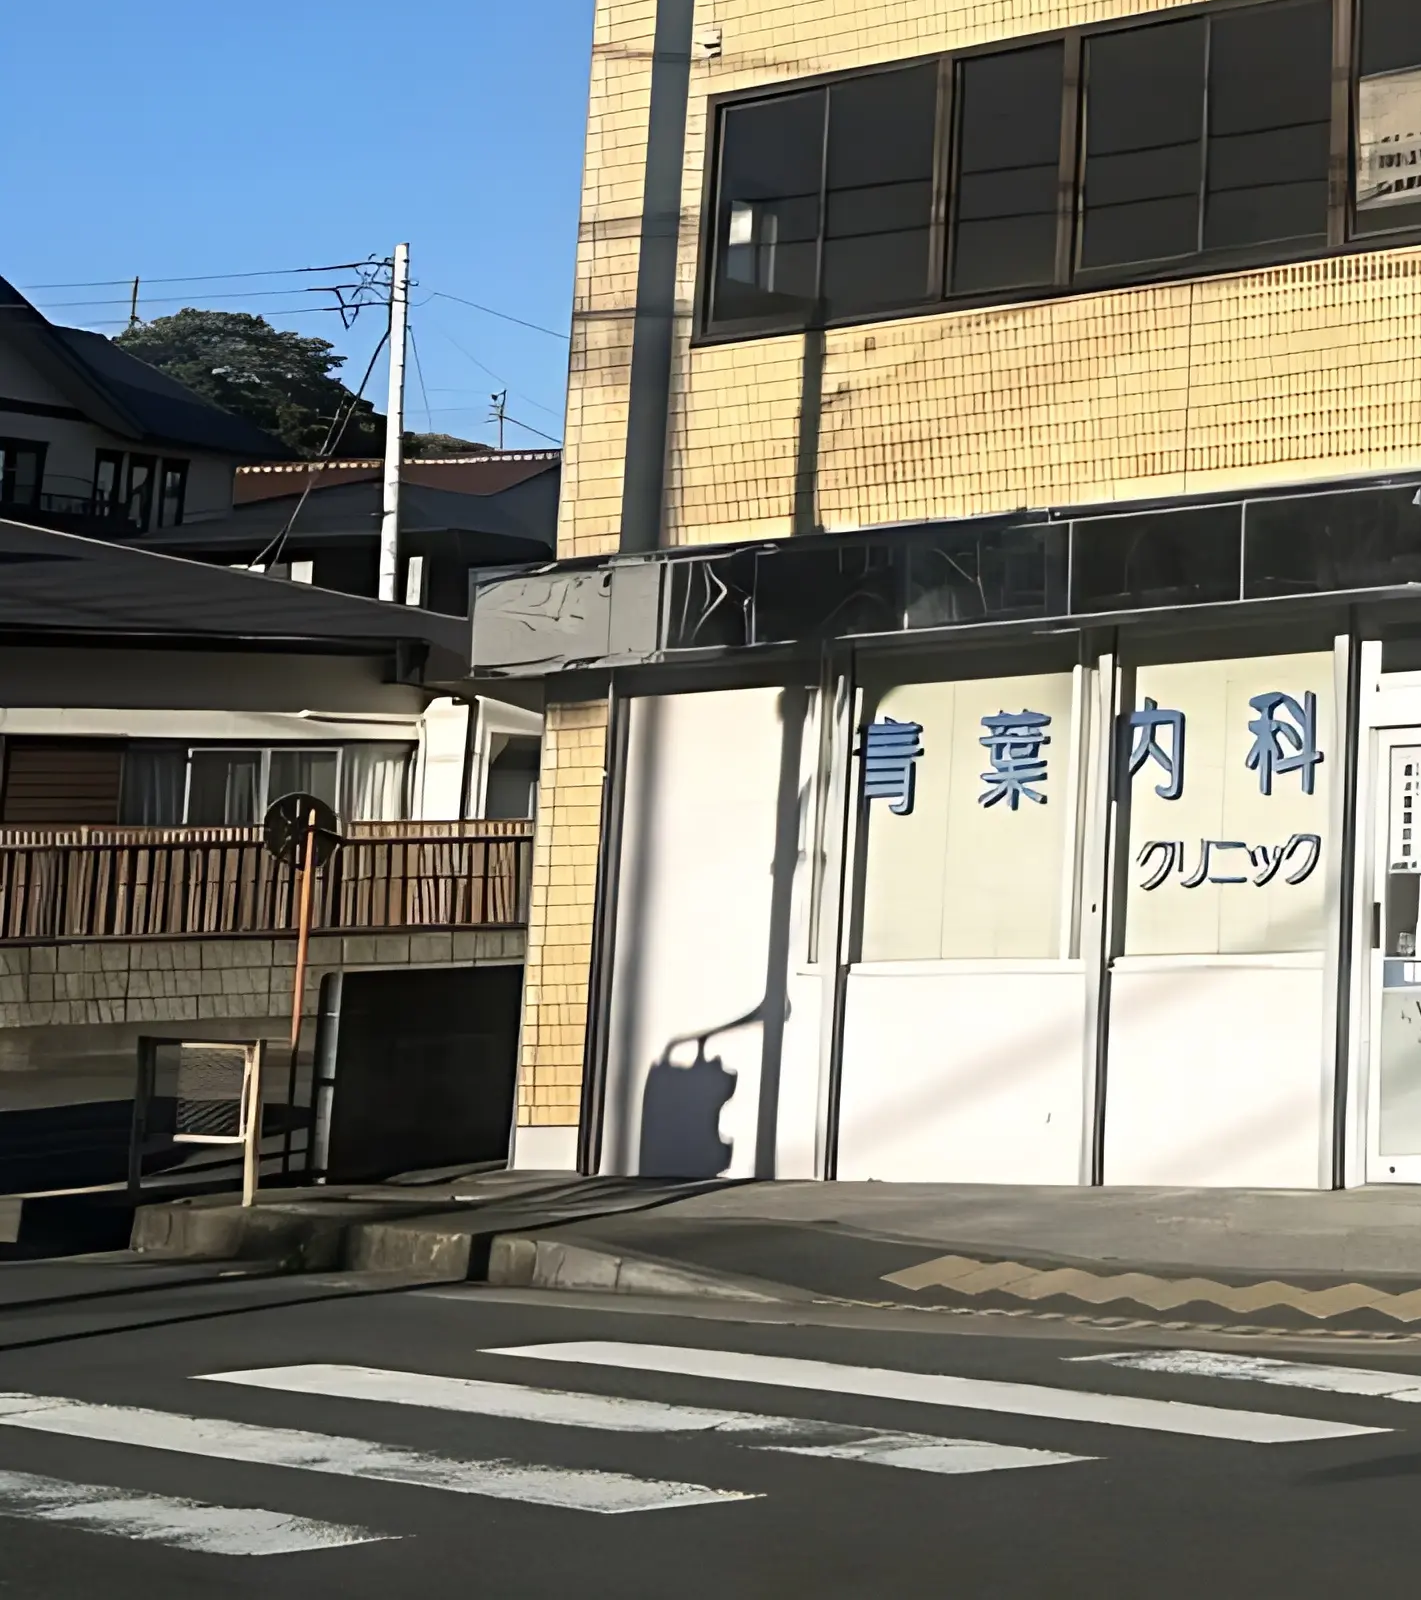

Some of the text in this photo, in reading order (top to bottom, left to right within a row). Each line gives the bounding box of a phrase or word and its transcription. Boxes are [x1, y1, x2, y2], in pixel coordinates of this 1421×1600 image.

[854, 690, 1324, 816] 青葉内科
[1136, 833, 1322, 891] クリニック
